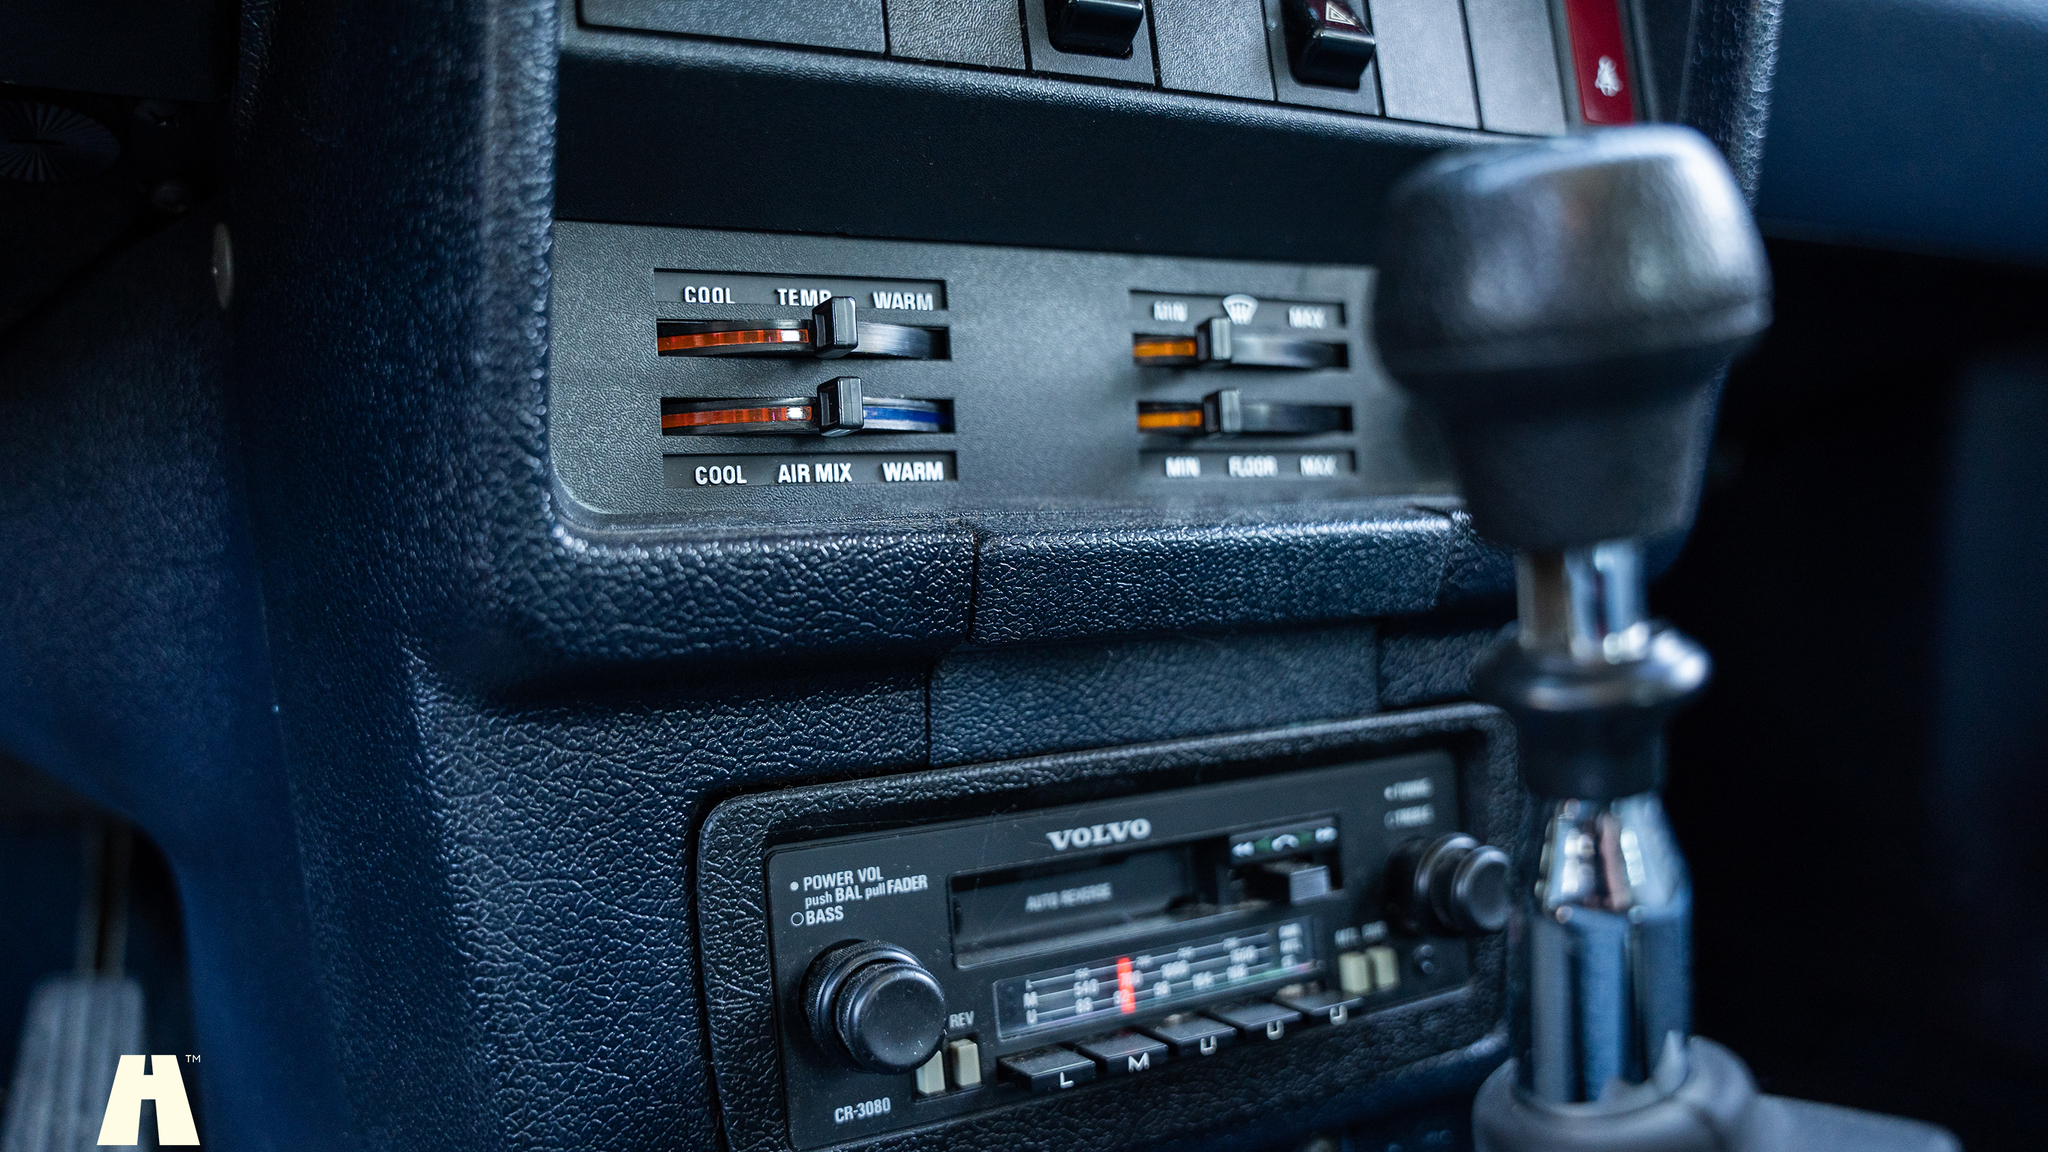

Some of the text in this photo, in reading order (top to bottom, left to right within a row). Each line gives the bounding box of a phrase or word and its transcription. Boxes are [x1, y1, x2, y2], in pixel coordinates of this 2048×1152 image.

[684, 285, 934, 311] COOL TEMP WARM
[1289, 305, 1327, 328] MAX
[695, 461, 944, 486] COOL AIR MIX WARM
[1165, 455, 1337, 478] MIN FLOOR MAX
[1046, 818, 1151, 850] VOLVO
[803, 866, 884, 892] POWER VOL
[804, 874, 929, 910] push BAL pull FADER
[805, 905, 844, 926] BASS
[949, 1010, 975, 1029] REV
[1329, 1004, 1348, 1026] U
[1266, 1019, 1284, 1041] U
[1200, 1035, 1217, 1056] U
[1128, 1052, 1150, 1072] M
[1060, 1071, 1074, 1089] L
[834, 1096, 892, 1124] CR-3080
